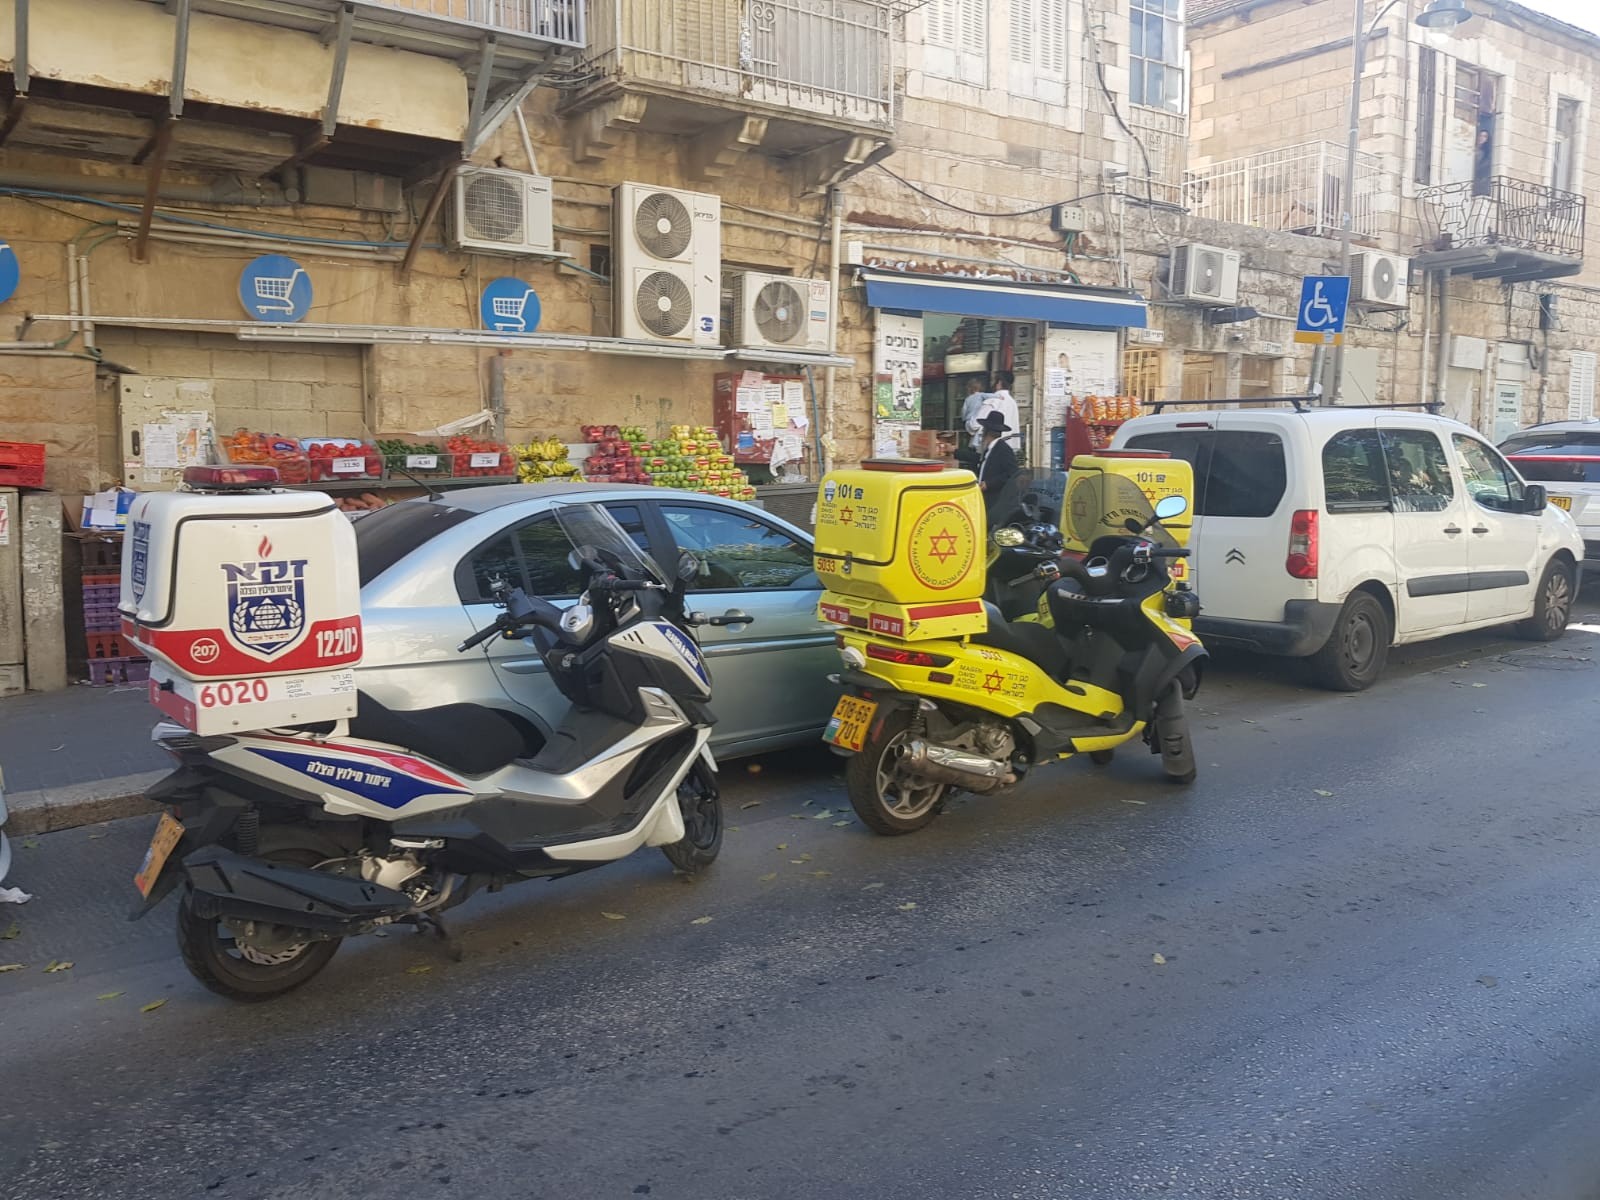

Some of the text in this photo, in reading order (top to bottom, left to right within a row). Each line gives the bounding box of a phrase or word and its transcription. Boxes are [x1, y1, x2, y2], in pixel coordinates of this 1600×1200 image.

[885, 335, 919, 349] ברוכים
[1136, 472, 1153, 483] 101
[838, 484, 853, 499] 101
[856, 505, 867, 513] דוד
[937, 506, 954, 514] אדום
[862, 514, 877, 522] אדום
[854, 521, 877, 530] בישראל
[816, 558, 836, 573] 5033
[221, 559, 308, 584] זקא
[920, 572, 938, 586] DAVID
[937, 574, 958, 586] ADOM
[193, 645, 217, 657] 207
[959, 664, 983, 673] MAGEN
[957, 677, 977, 685] ADOM
[1007, 673, 1018, 681] דוד
[1012, 682, 1026, 690] אדום
[200, 679, 268, 708] 6020
[1001, 688, 1025, 698] בישראל
[836, 698, 872, 724] 318-66
[838, 720, 859, 743] 701
[306, 760, 392, 788] איתור חילוץ הצלה
